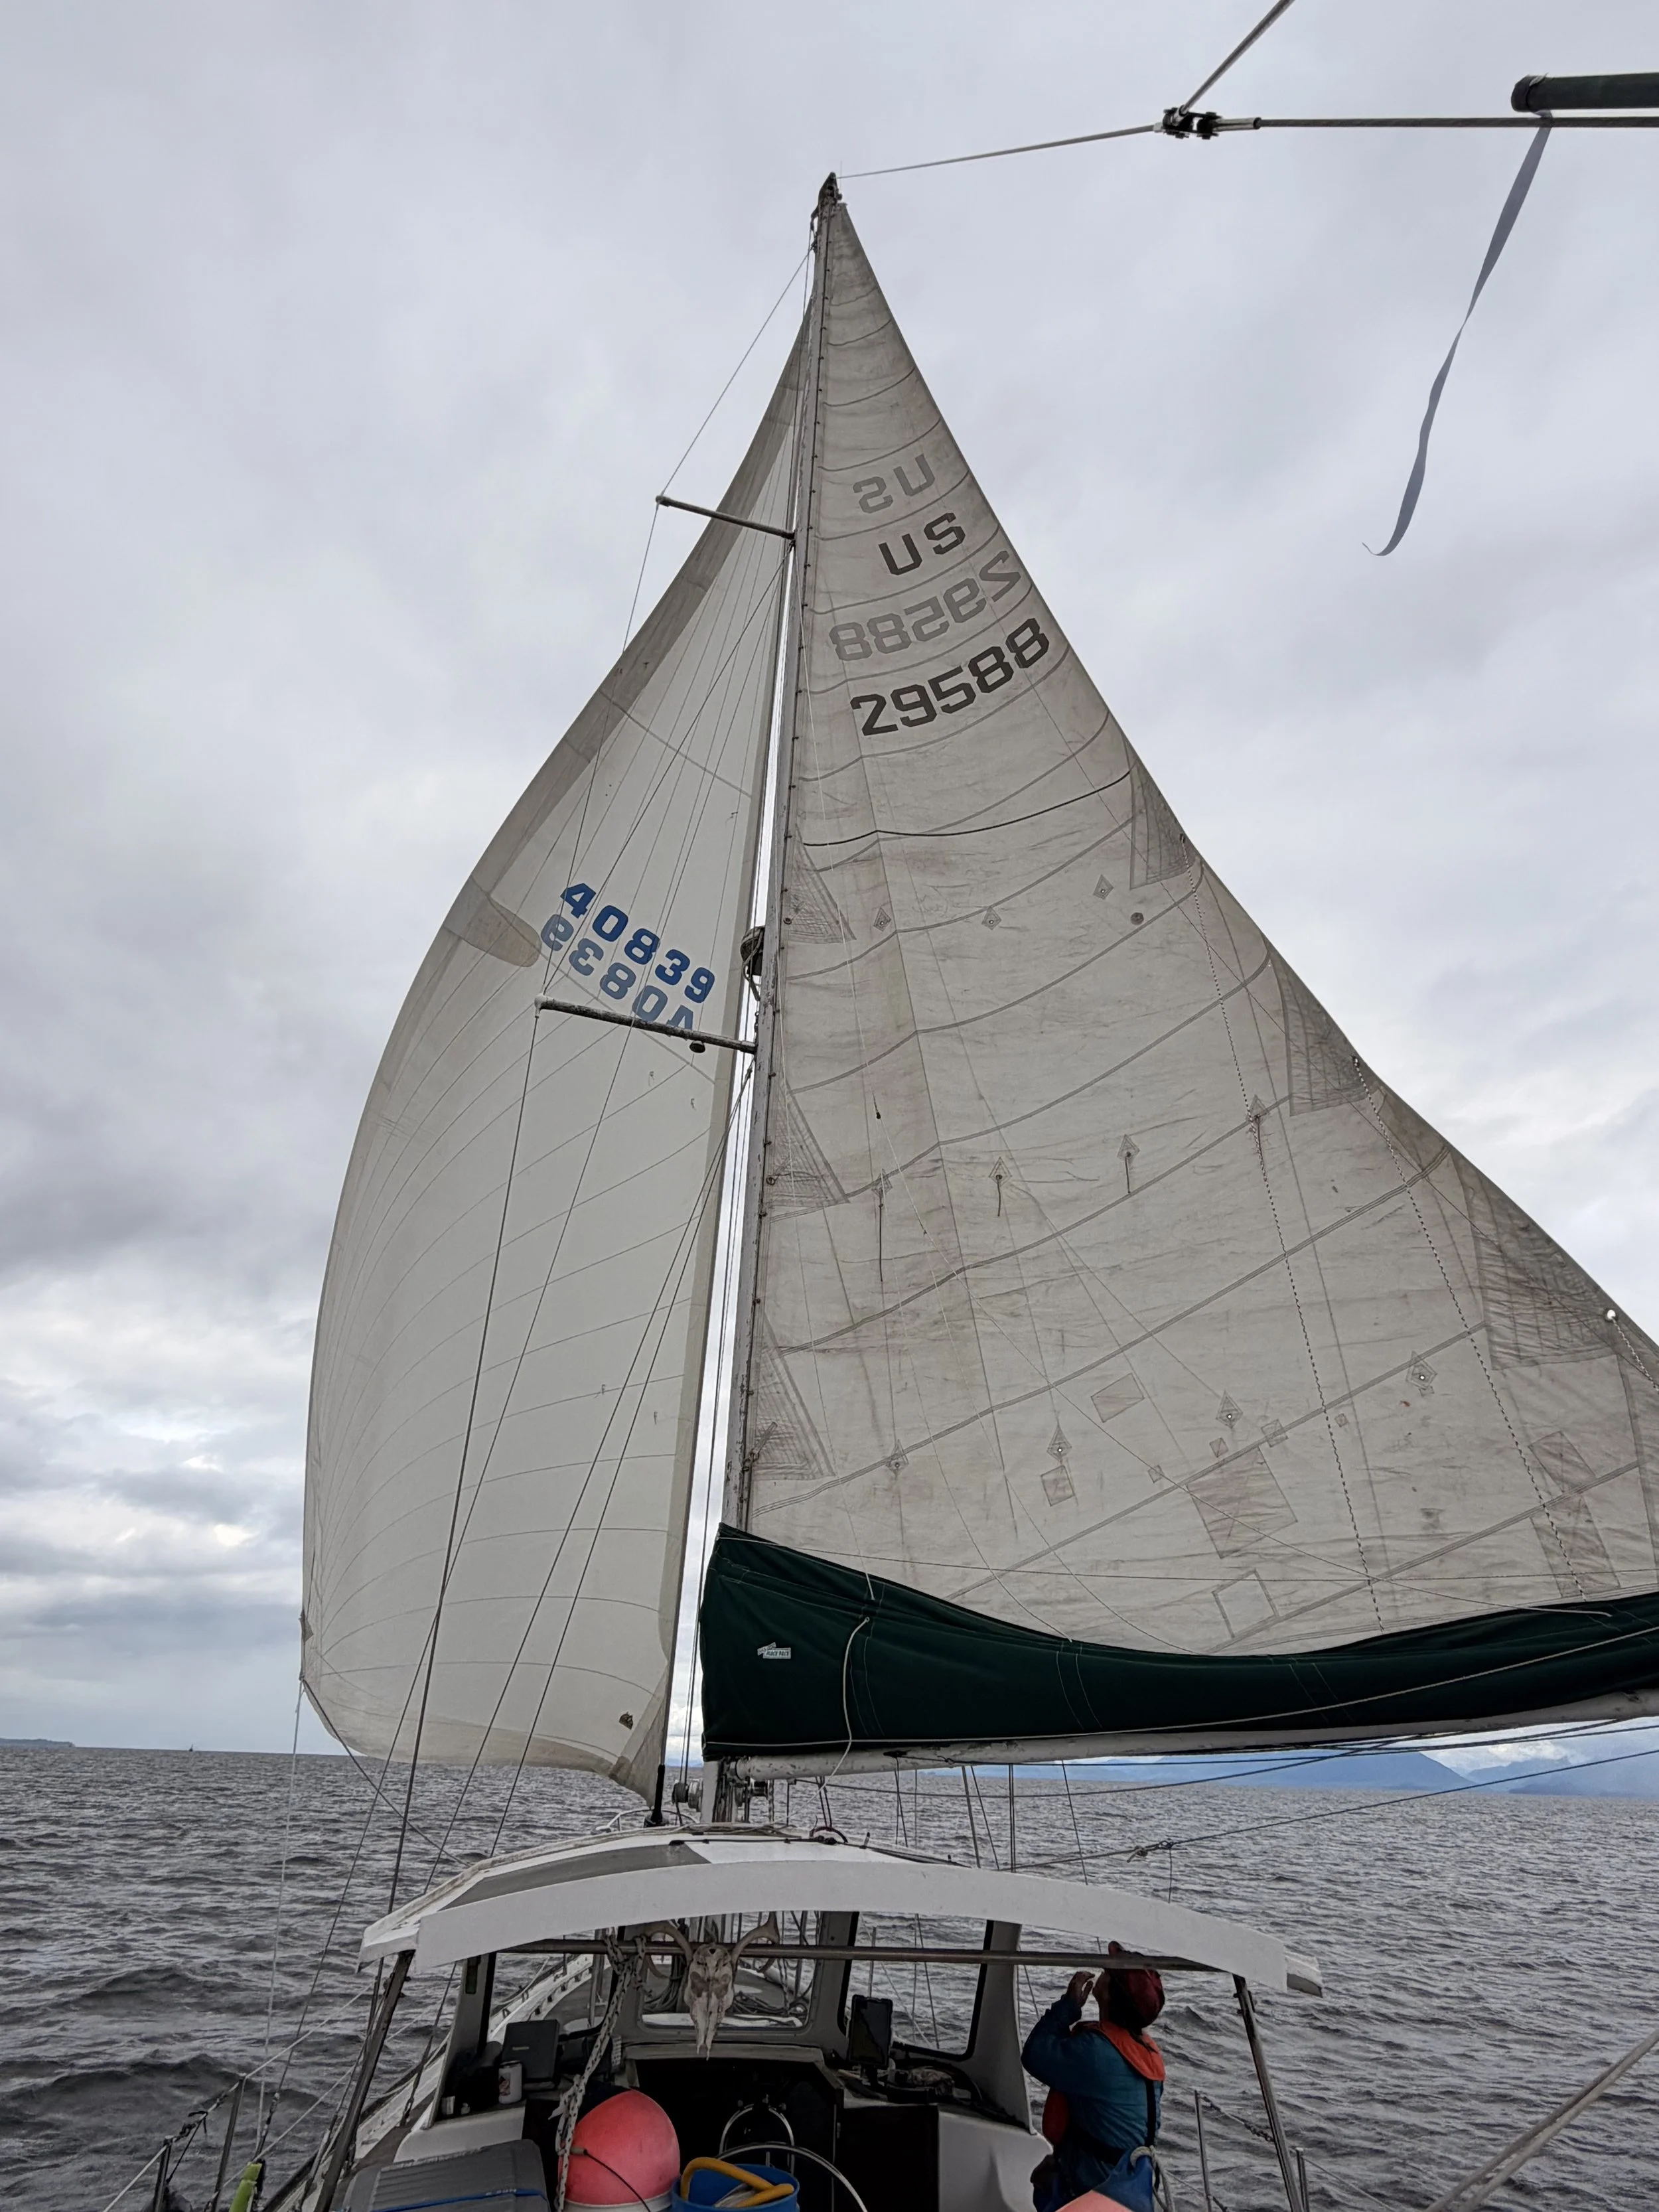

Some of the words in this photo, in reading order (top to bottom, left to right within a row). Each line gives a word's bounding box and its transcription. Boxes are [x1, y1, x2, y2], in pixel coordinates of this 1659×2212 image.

[878, 512, 966, 575] US
[850, 618, 1049, 736] 29588
[560, 883, 715, 1003] 40839
